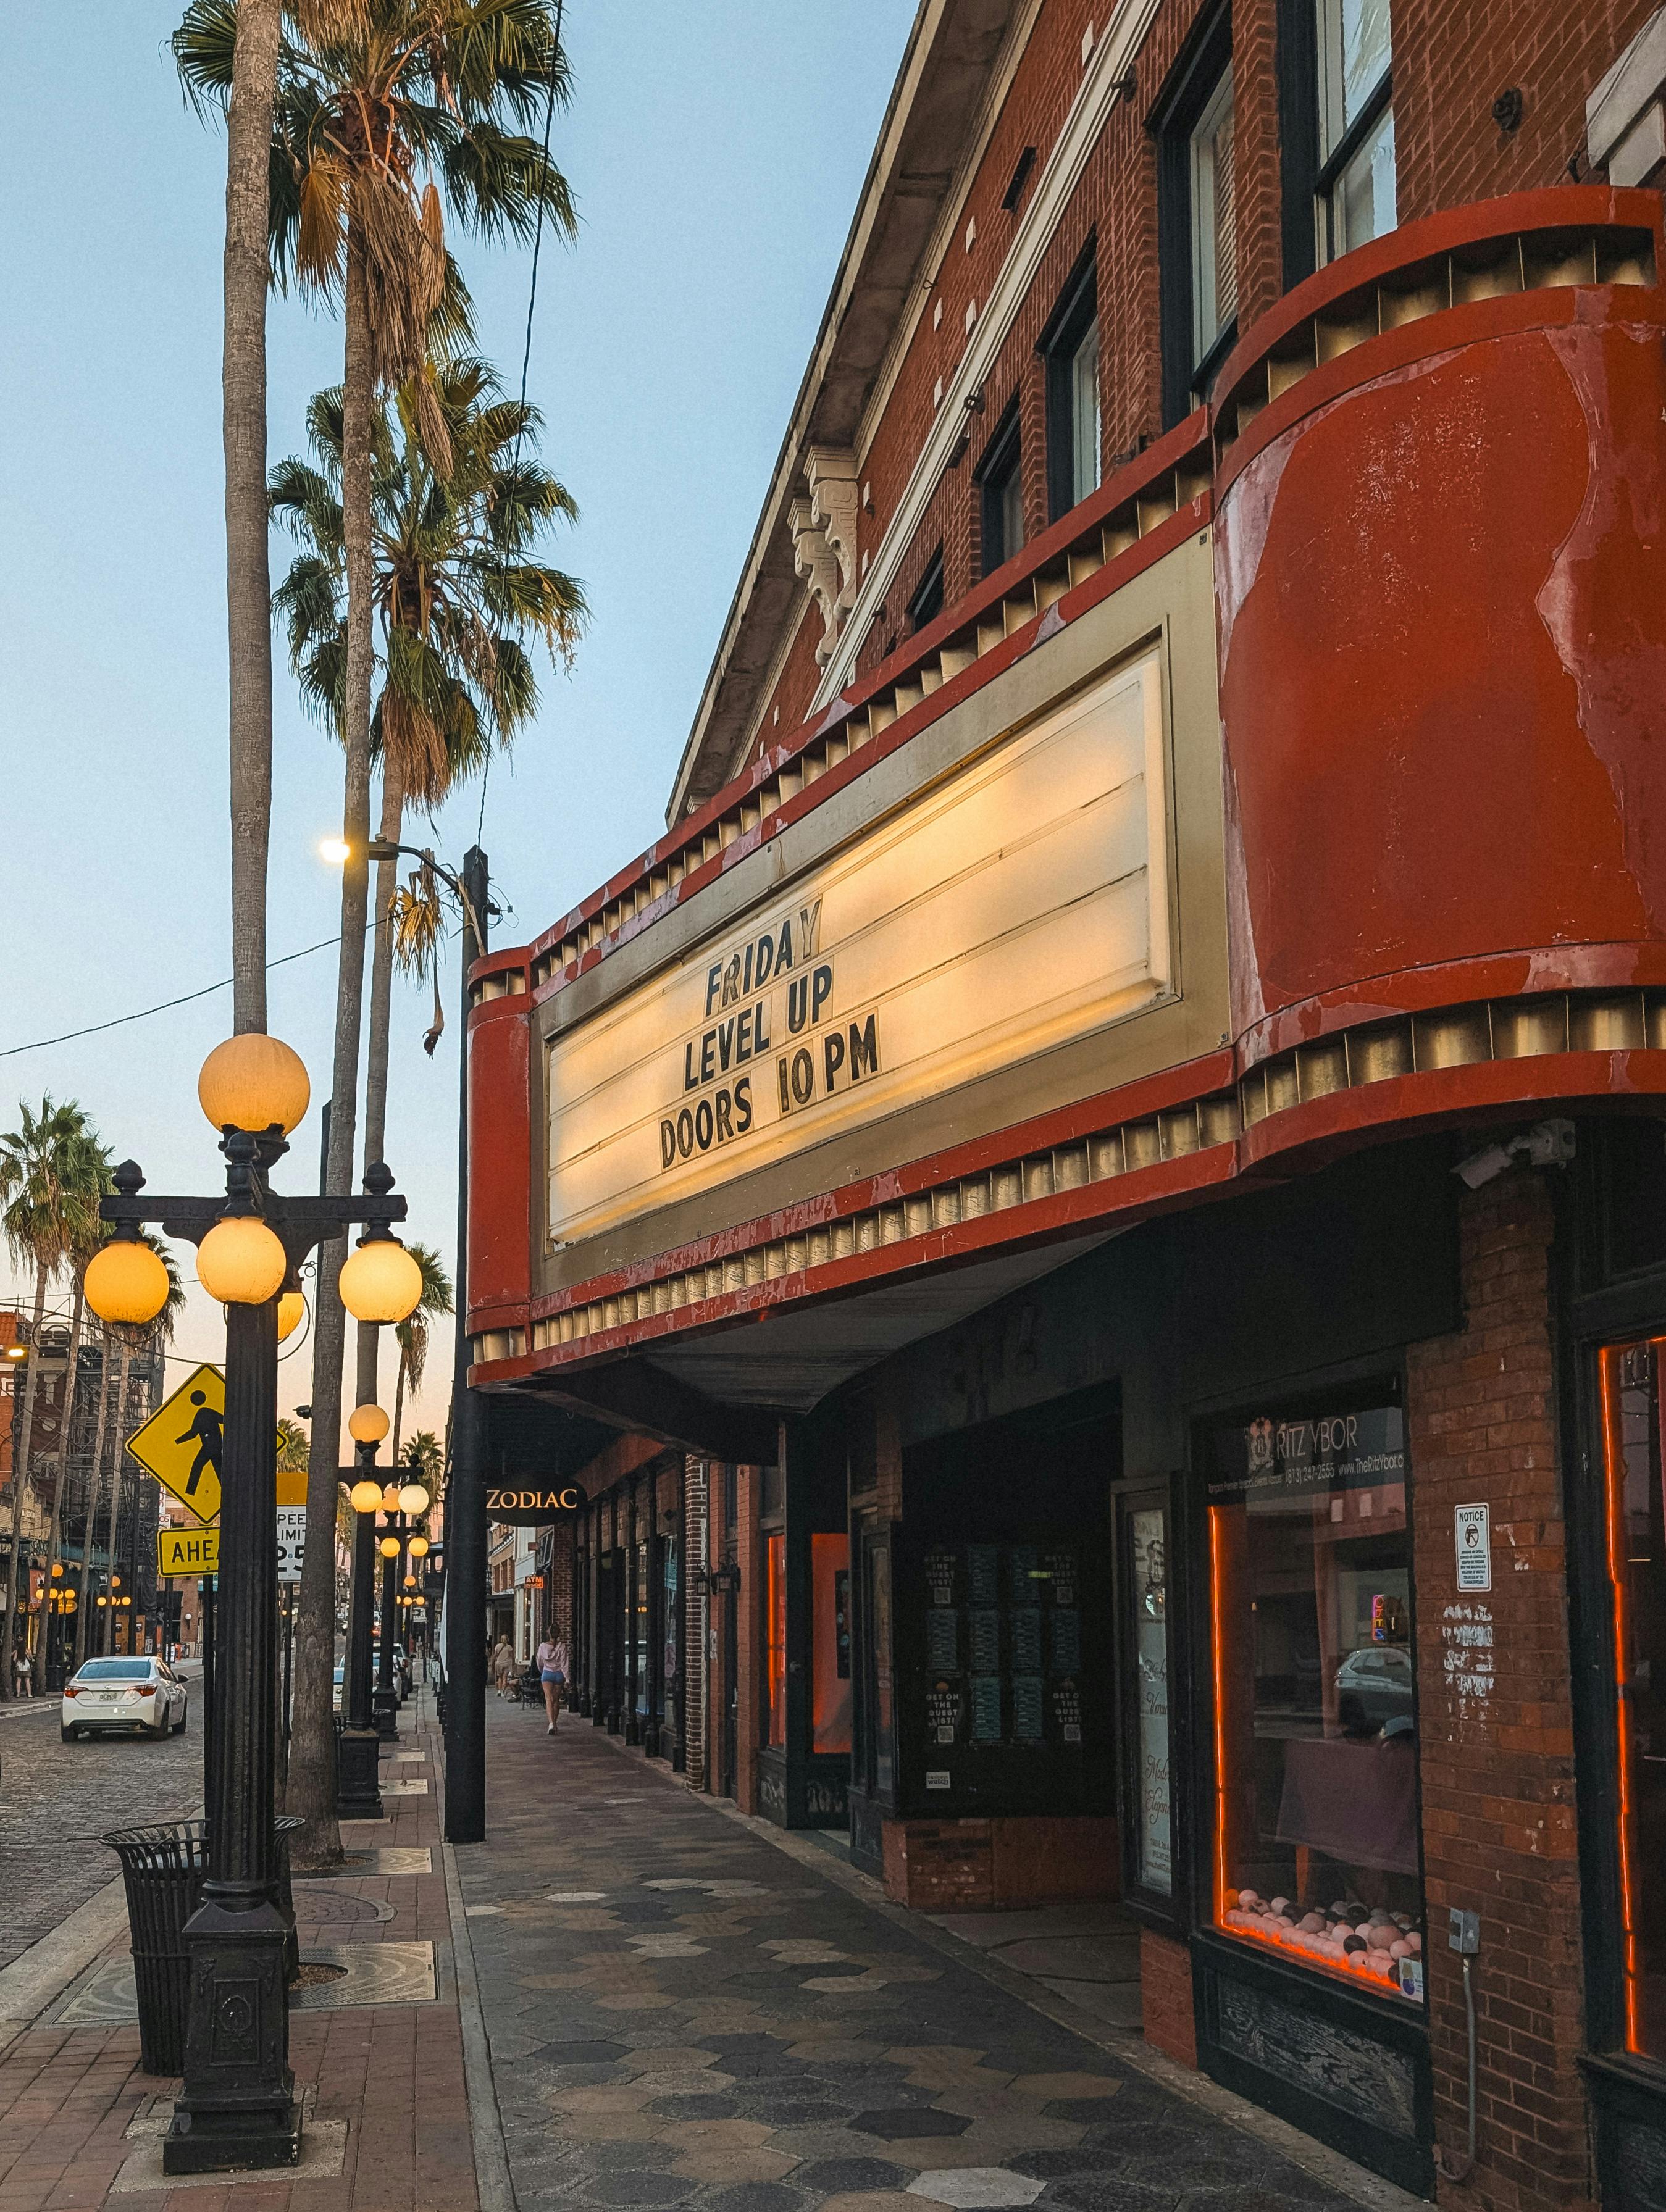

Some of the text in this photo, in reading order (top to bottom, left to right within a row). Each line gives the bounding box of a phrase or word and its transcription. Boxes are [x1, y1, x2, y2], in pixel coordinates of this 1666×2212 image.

[705, 899, 823, 1017] FRIDAY
[684, 964, 832, 1091] LEVEL UP
[660, 1077, 752, 1169] DOORS
[824, 1013, 879, 1093] PM
[1276, 1416, 1357, 1459] RITZ YBOR
[486, 1488, 577, 1509] ZODIAC
[278, 1514, 306, 1525] PEE
[1459, 1511, 1484, 1522] NOTICE
[277, 1530, 306, 1541] IMI
[172, 1540, 219, 1563] AHE
